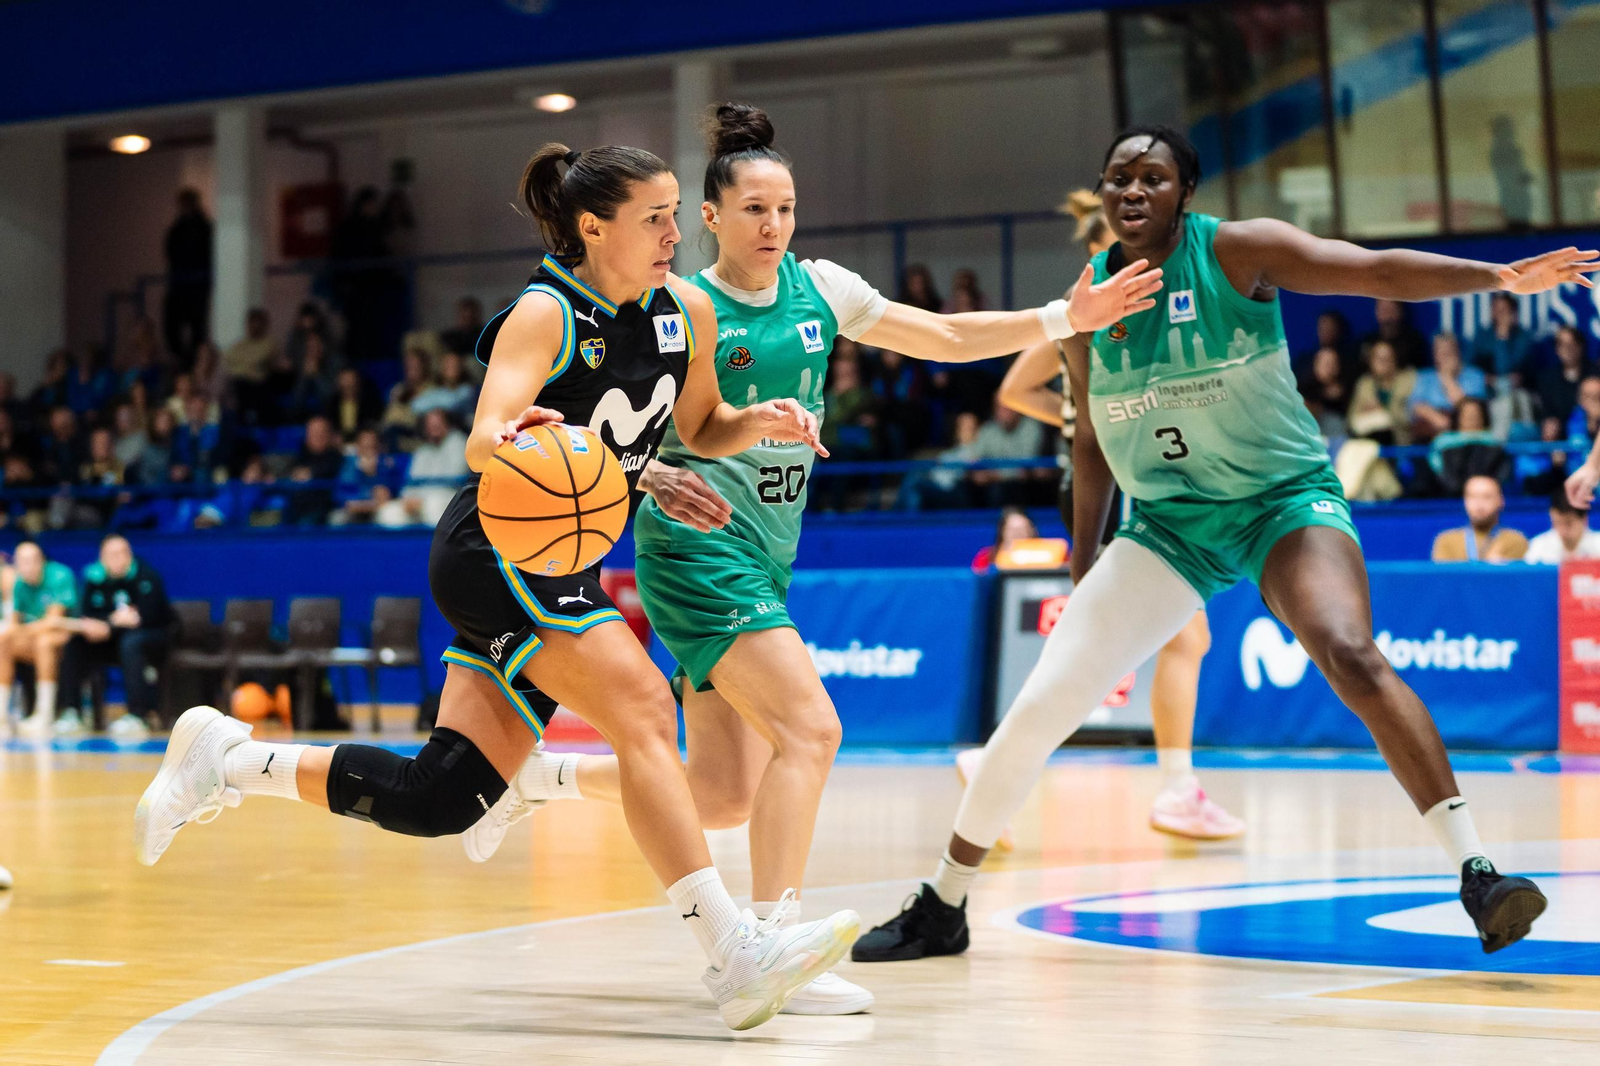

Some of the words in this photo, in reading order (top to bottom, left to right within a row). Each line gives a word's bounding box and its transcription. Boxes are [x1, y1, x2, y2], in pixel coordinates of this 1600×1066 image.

[720, 327, 748, 339] vive
[1162, 391, 1228, 410] ambiental
[1155, 427, 1189, 460] 3
[757, 463, 806, 505] 20
[726, 616, 751, 630] vive
[805, 640, 923, 677] ovistar
